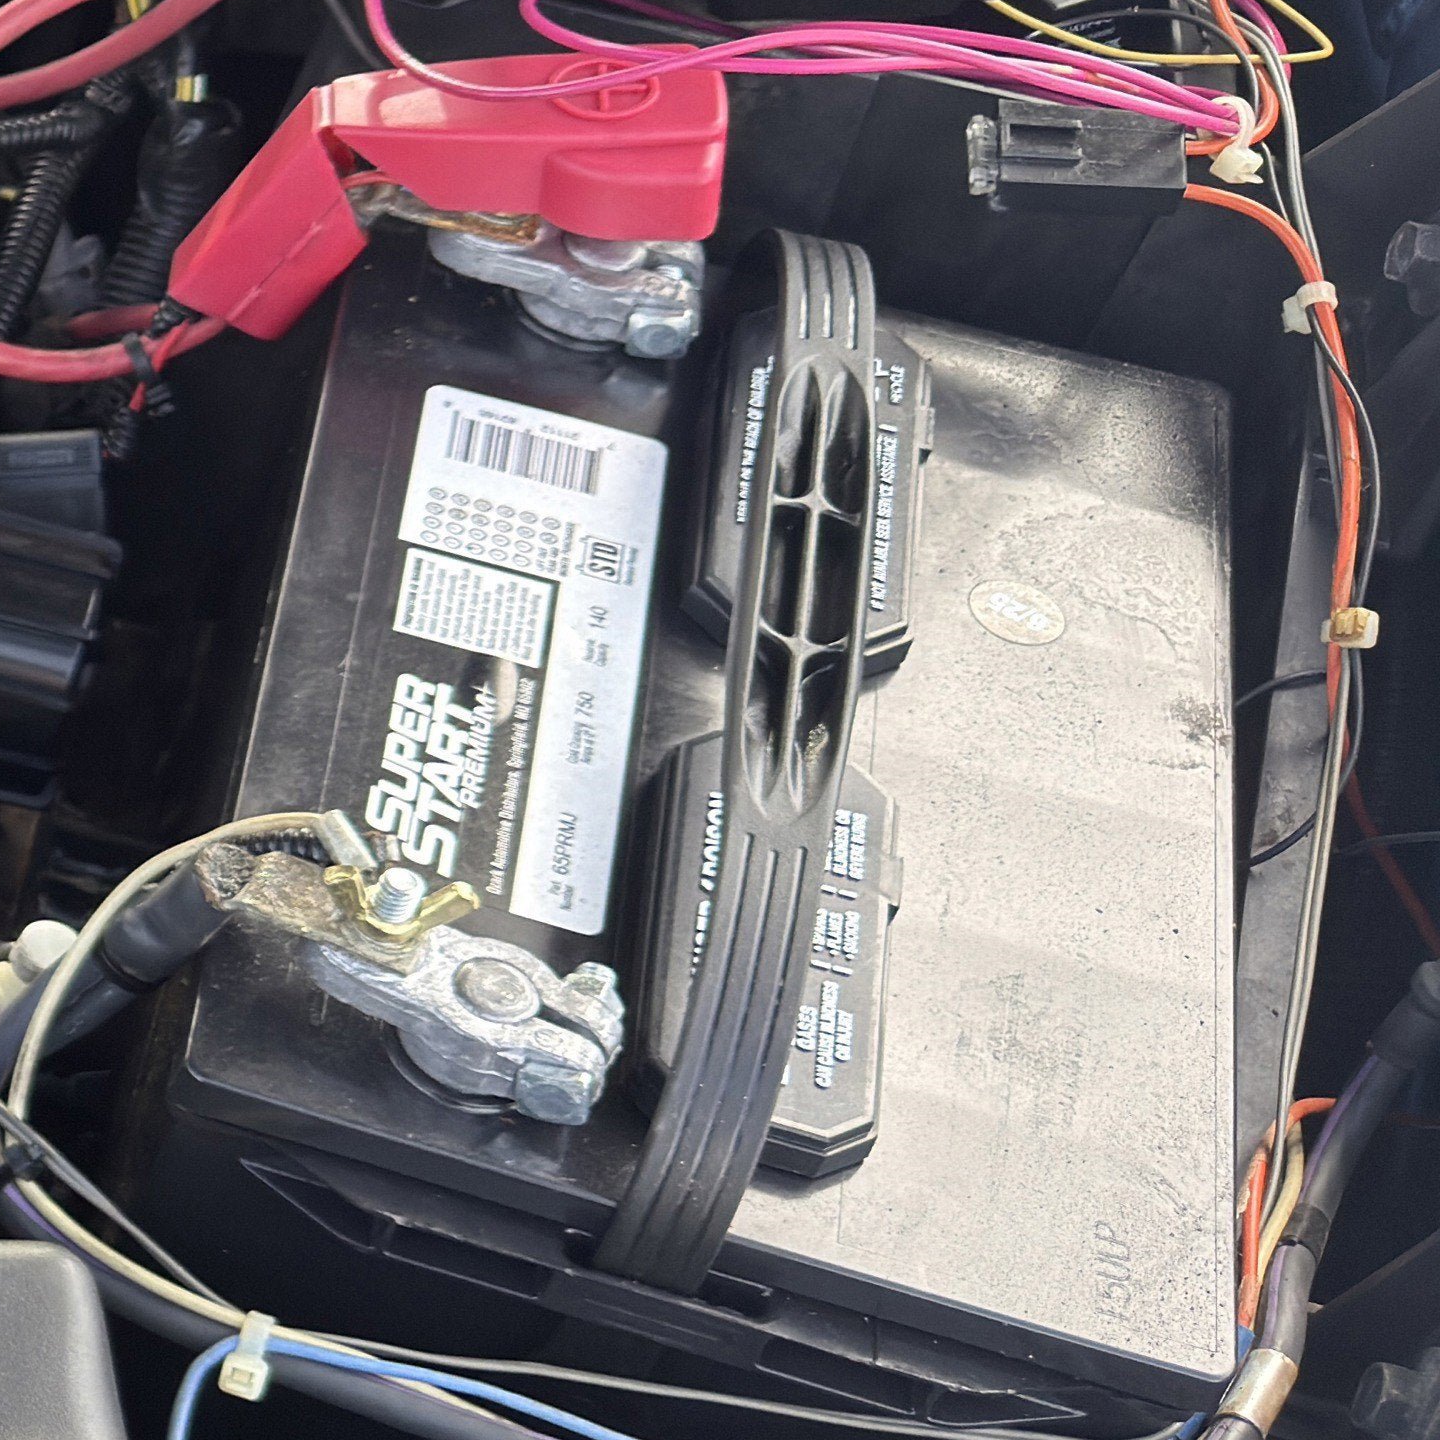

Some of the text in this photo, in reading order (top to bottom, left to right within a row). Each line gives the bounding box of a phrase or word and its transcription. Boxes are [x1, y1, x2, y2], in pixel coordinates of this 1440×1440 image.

[879, 435, 900, 484] ASSISTANCE
[877, 482, 895, 518] SERVICE
[875, 517, 892, 540] SEEK
[588, 540, 619, 577] STD
[872, 539, 891, 581] AVAILABLE
[870, 580, 887, 600] NOT
[588, 604, 607, 630] 140
[575, 690, 594, 718] 750
[365, 673, 437, 842] SUPER
[459, 691, 496, 809] PREMIUM
[401, 682, 476, 878] START
[491, 819, 511, 870] Automotive
[552, 809, 578, 876] 65PRMJ
[486, 869, 505, 894] Ozark
[795, 1004, 817, 1050] GASES
[816, 979, 840, 1033] BLINDNESS
